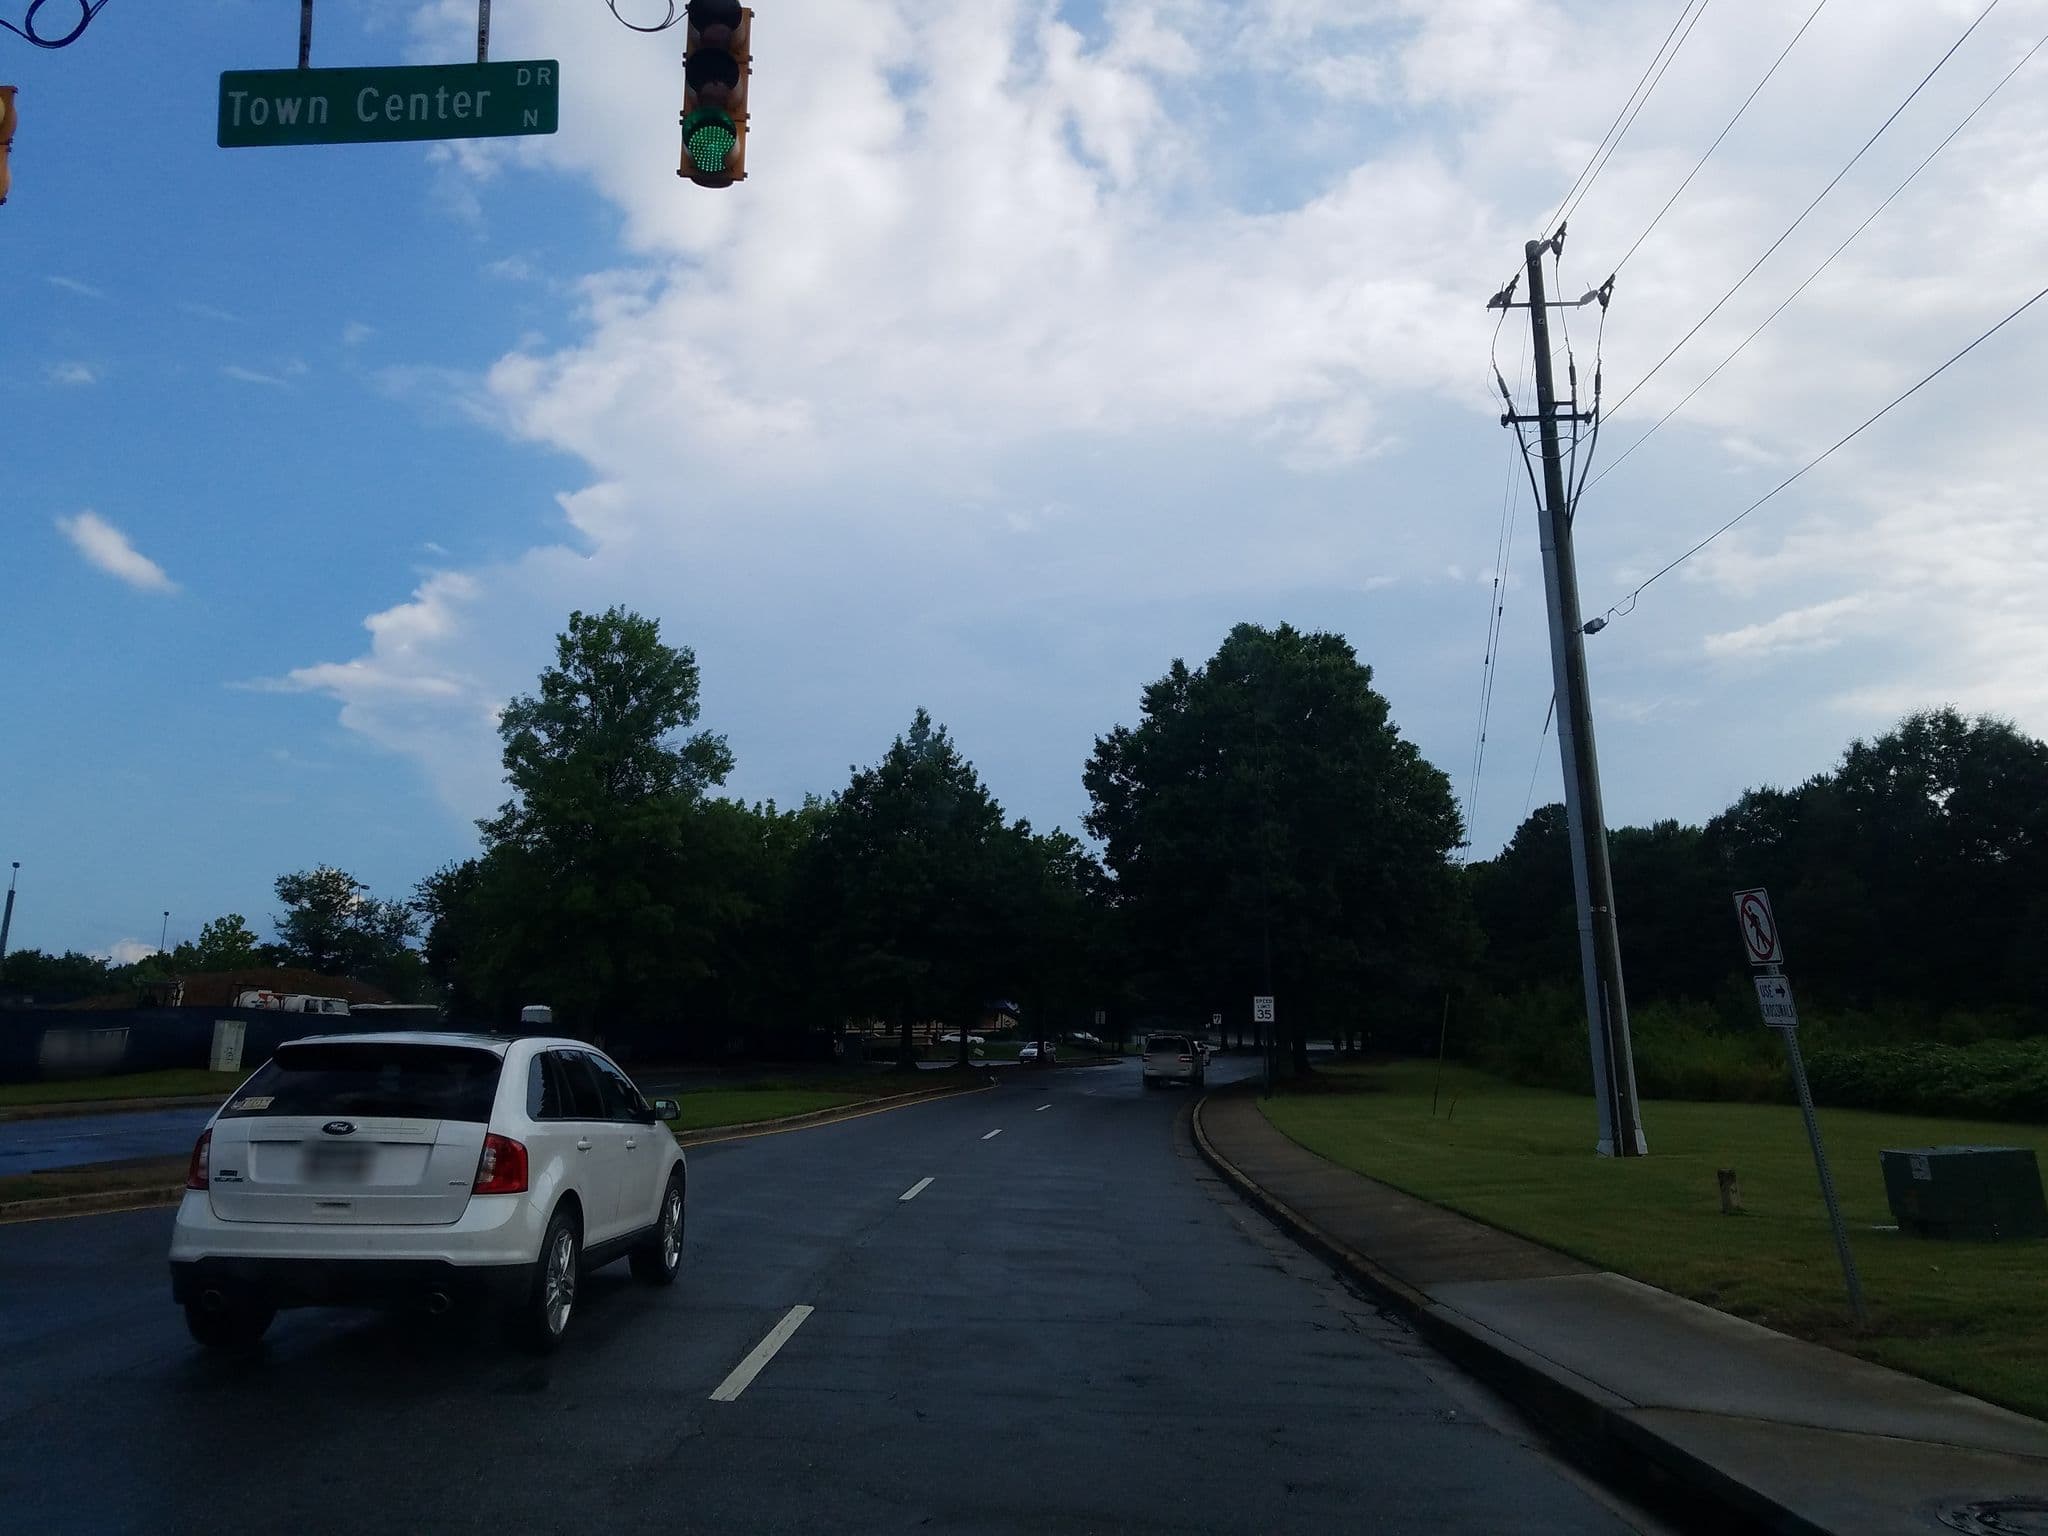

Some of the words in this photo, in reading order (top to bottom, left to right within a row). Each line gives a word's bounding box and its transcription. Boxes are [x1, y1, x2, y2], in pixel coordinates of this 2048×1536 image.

[516, 66, 552, 87] DR
[228, 90, 328, 127] Town
[357, 85, 491, 122] Center
[523, 109, 538, 127] N
[1760, 985, 1774, 998] USE
[1258, 1010, 1271, 1019] 35
